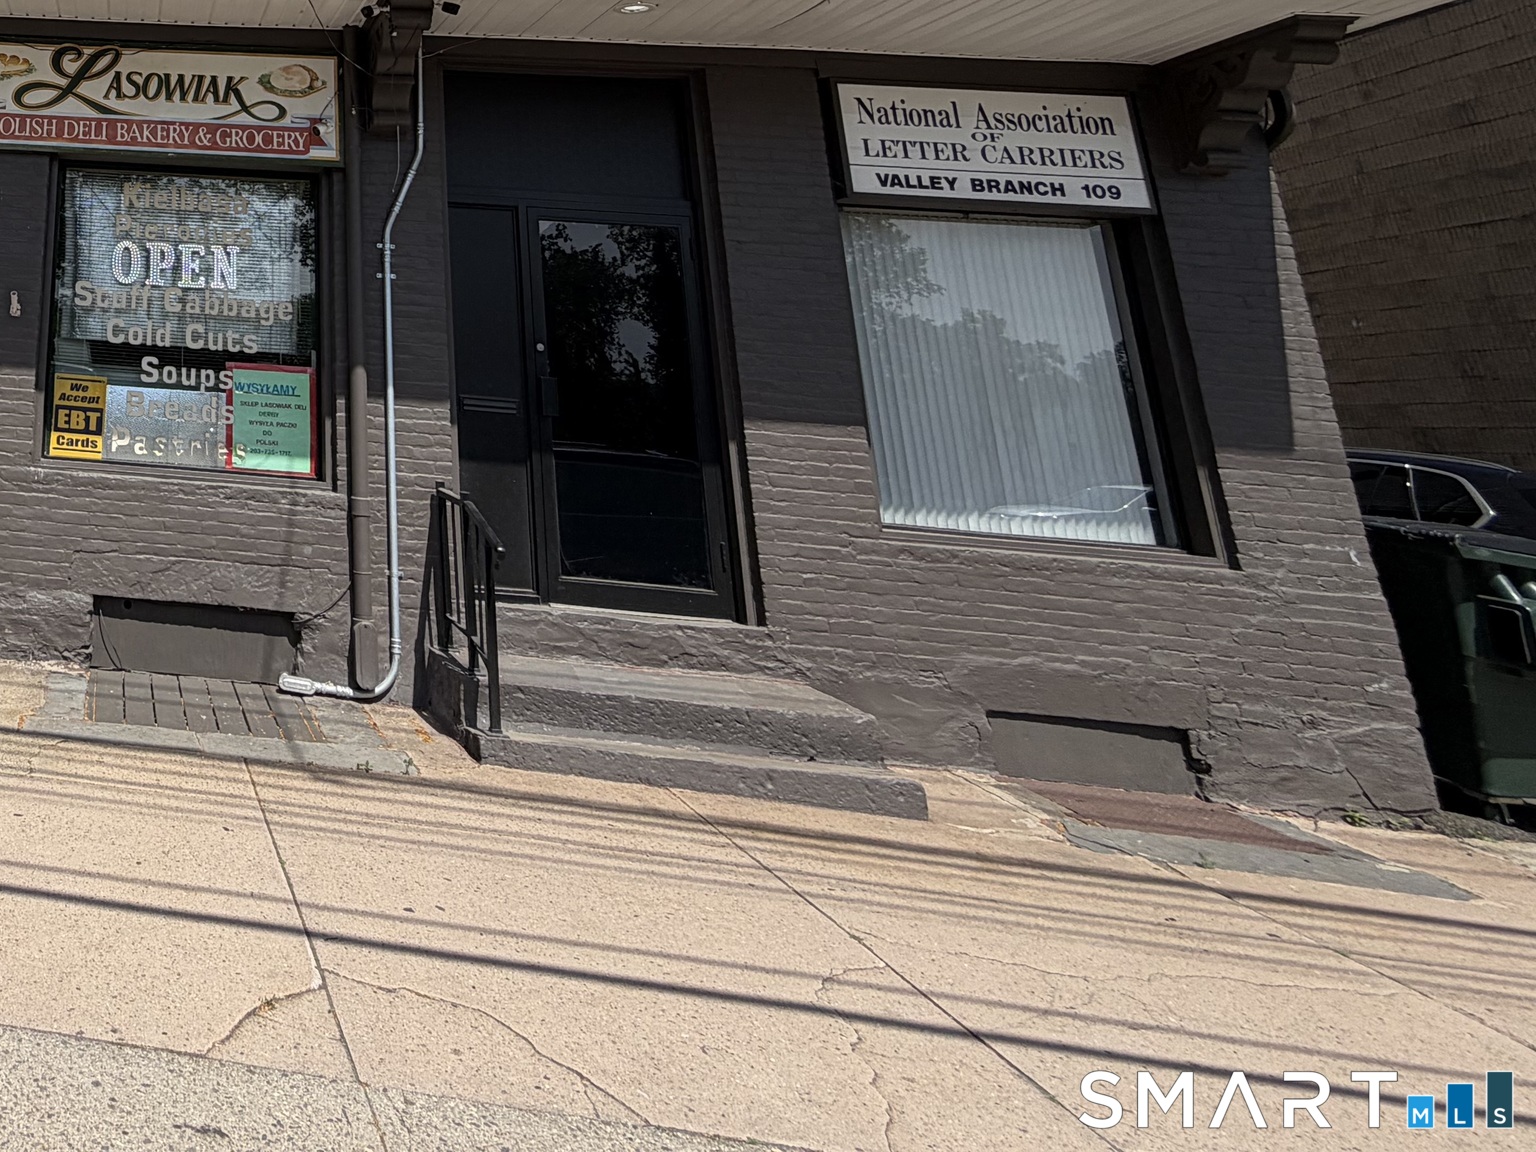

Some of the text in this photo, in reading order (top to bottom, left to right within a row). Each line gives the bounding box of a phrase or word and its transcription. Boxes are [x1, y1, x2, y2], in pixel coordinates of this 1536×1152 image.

[11, 43, 287, 123] LASOWIAK
[853, 97, 1117, 136] National Association
[63, 120, 108, 141] DELI
[117, 123, 193, 146] BAKERY
[195, 126, 212, 147] &
[216, 127, 309, 151] GROCERY
[971, 131, 1004, 143] OF
[860, 138, 1125, 170] LETTER CARRIERS
[122, 181, 249, 215] Kielbasa
[875, 172, 1122, 200] VALLEY BRANCH 109
[112, 240, 240, 289] OPEN
[74, 280, 293, 325] Stuff Cabbage
[106, 318, 258, 354] Cold Cuts
[70, 382, 89, 393] We
[140, 356, 233, 393] Soups
[234, 381, 297, 396] WYSYŁAMY
[58, 392, 101, 405] Accept
[126, 390, 235, 425] Breads
[57, 409, 101, 431] EBT
[56, 434, 98, 449] Cards
[110, 425, 246, 463] Pastries
